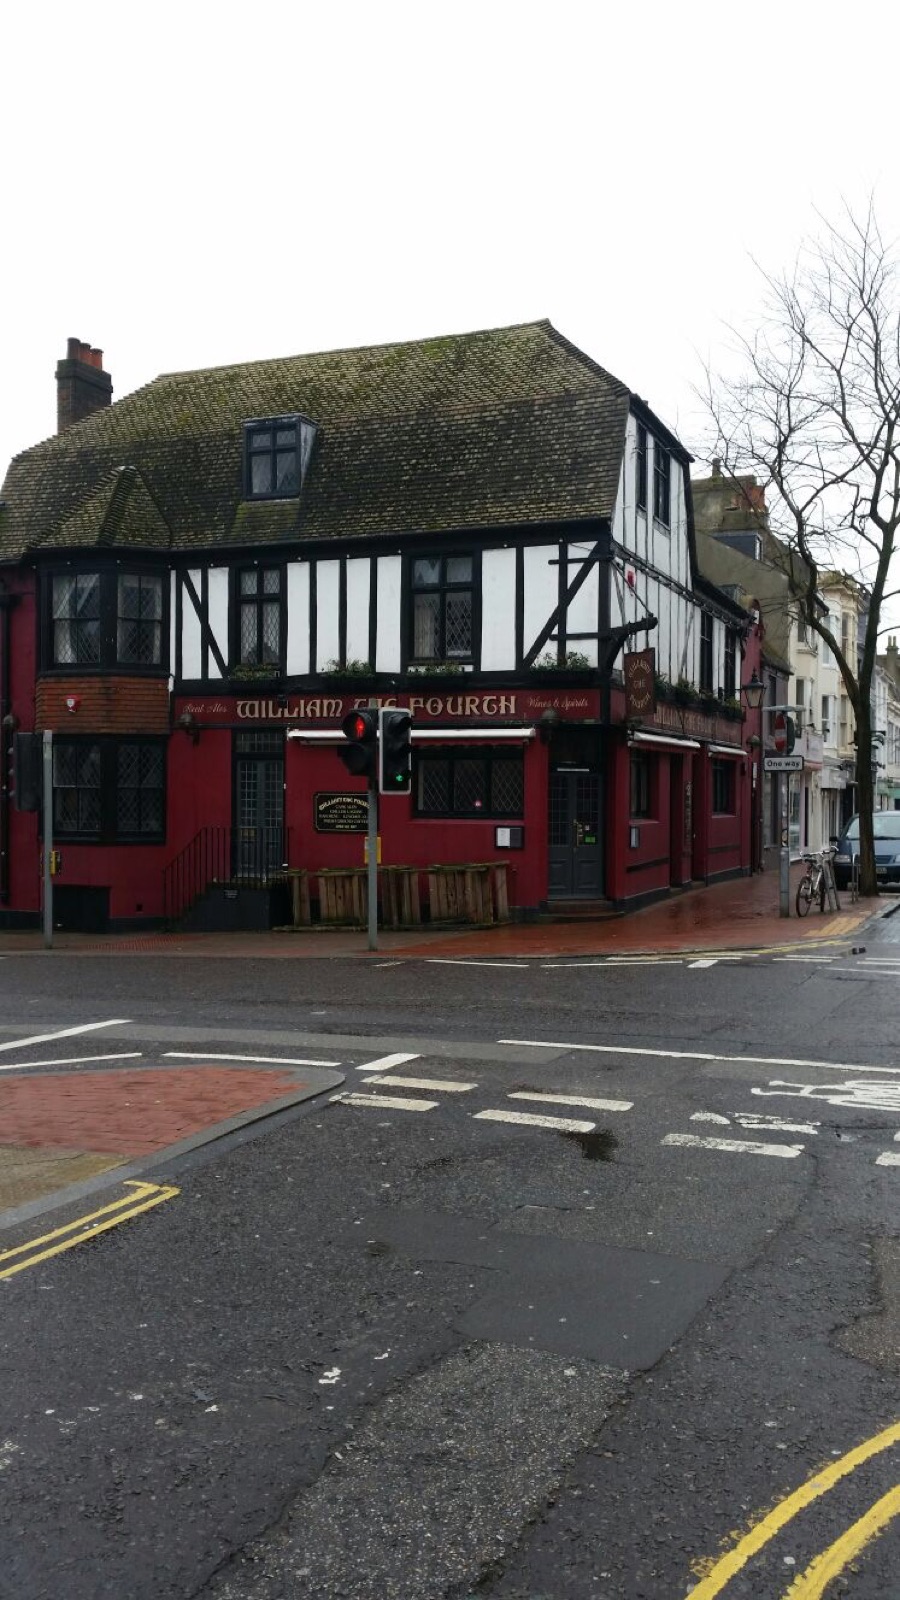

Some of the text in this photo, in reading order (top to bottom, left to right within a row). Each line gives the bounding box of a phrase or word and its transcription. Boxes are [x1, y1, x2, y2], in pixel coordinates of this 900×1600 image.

[236, 698, 343, 719] WILLIAM
[409, 694, 516, 716] FOURTH
[527, 697, 552, 708] Wines
[560, 696, 589, 710] Spirits
[767, 759, 800, 769] One way
